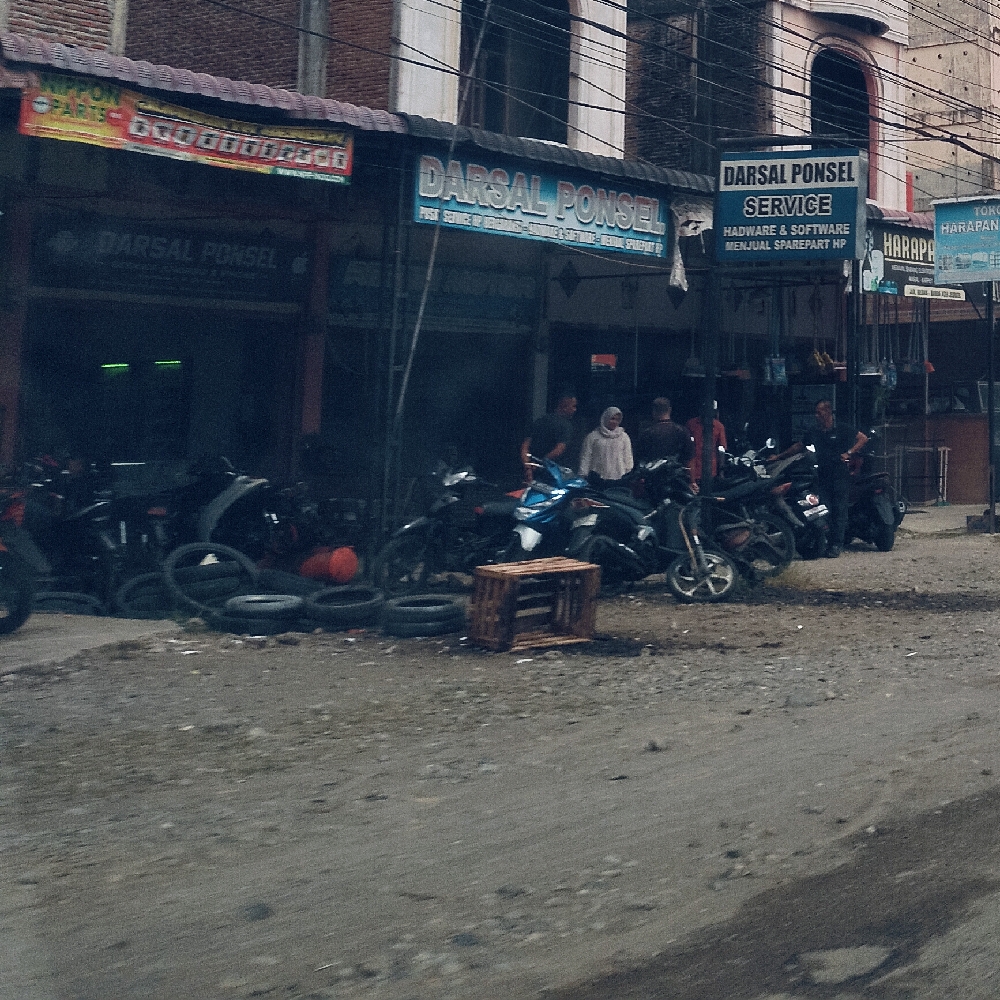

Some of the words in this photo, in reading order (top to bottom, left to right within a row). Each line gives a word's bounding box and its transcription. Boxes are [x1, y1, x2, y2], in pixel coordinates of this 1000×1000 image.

[723, 164, 787, 186] DARSAL
[791, 161, 855, 184] PONSEL
[418, 154, 548, 217] DARSAL
[556, 181, 666, 235] PONSEL
[743, 193, 832, 218] SERVICE
[723, 224, 777, 237] HADWARE
[780, 224, 788, 236] &
[790, 223, 851, 236] SOFTWARE
[940, 219, 999, 235] HARAPAN
[725, 239, 771, 251] MENJUAL
[774, 238, 830, 250] SPAREPART
[833, 238, 846, 249] HP
